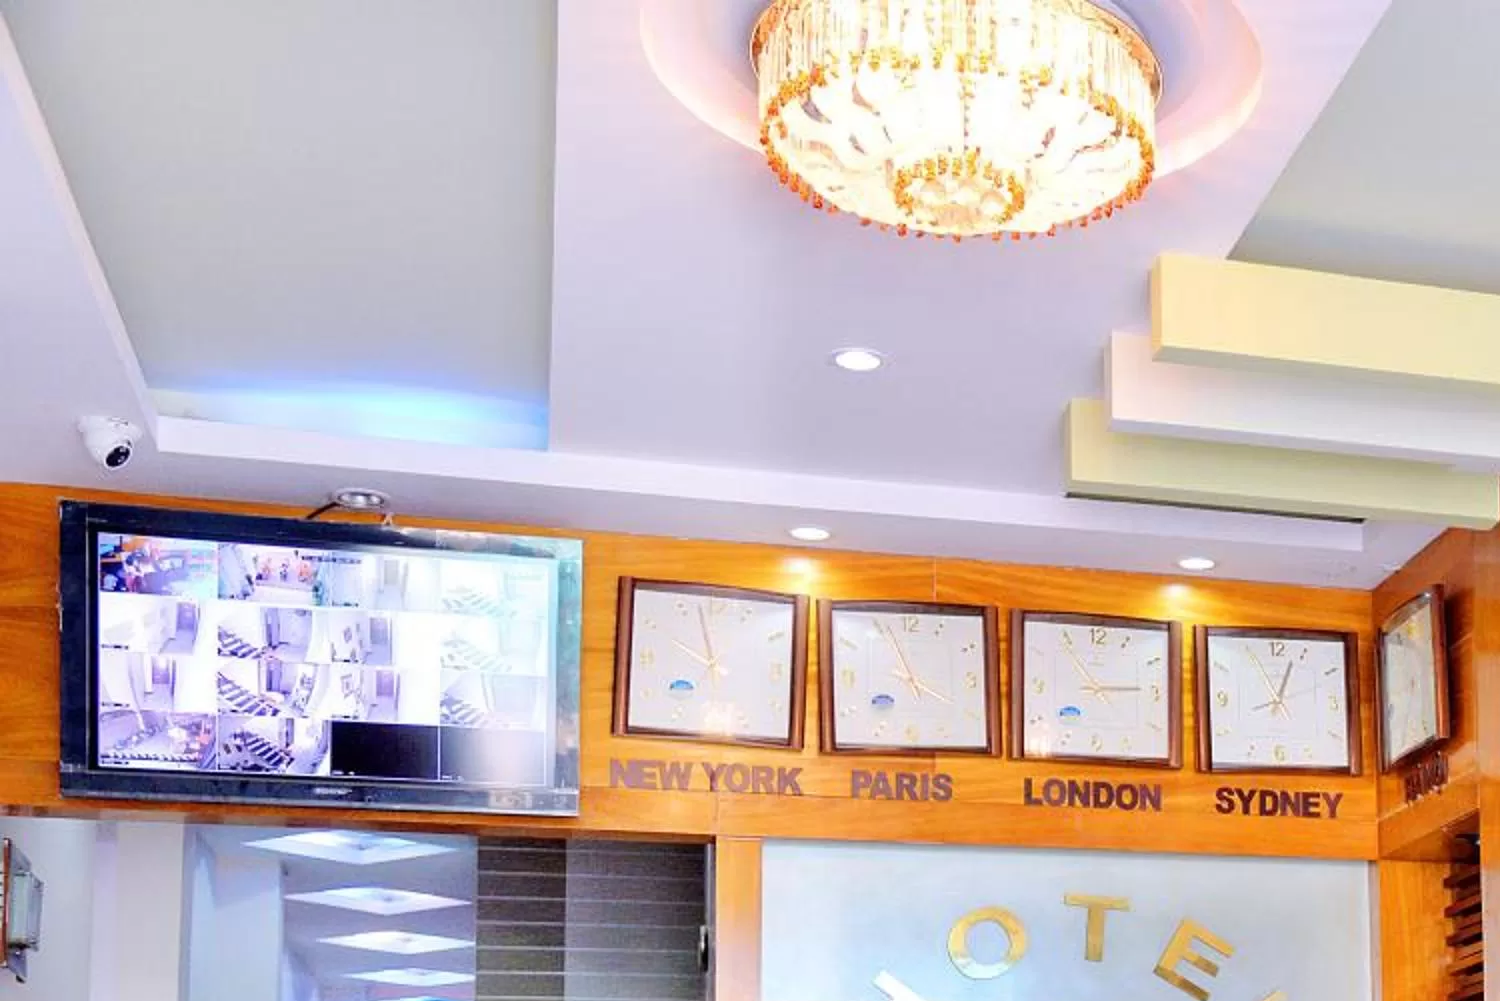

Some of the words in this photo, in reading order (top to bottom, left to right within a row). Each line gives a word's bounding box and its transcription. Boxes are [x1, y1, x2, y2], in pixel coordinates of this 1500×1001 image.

[1090, 628, 1107, 645] 12
[1270, 641, 1285, 657] 12
[609, 758, 693, 791] NEW
[701, 762, 805, 796] YORK
[851, 769, 953, 802] PARIS
[1023, 777, 1163, 812] LONDON
[1215, 787, 1343, 819] SYDNEY
